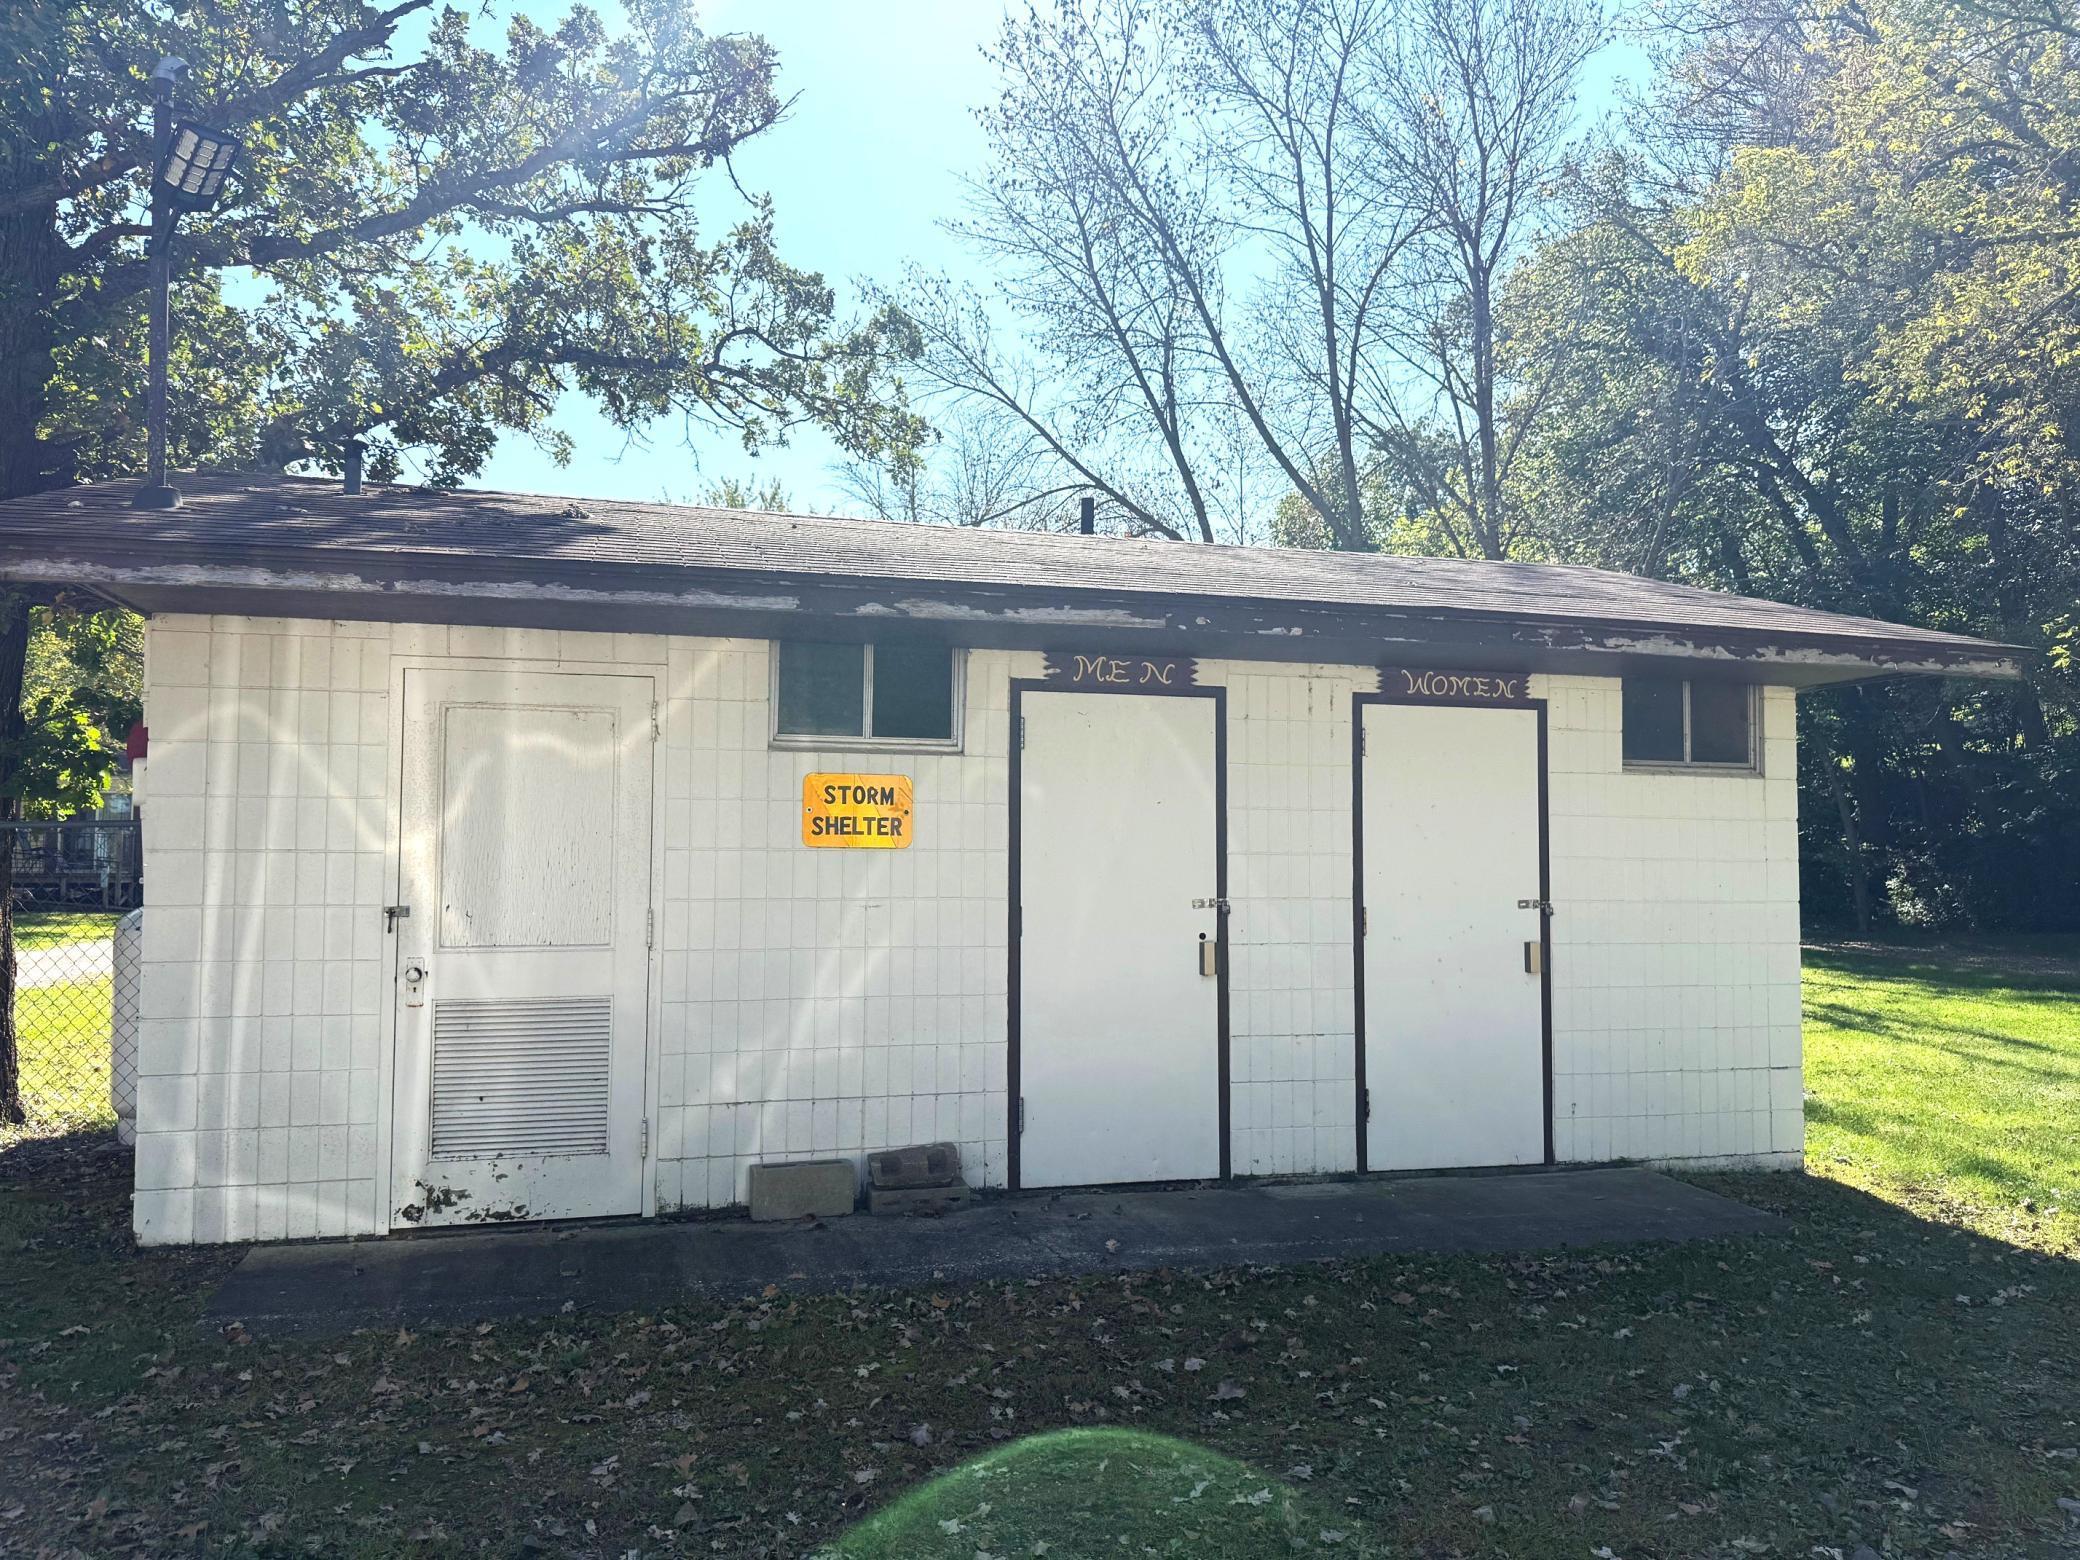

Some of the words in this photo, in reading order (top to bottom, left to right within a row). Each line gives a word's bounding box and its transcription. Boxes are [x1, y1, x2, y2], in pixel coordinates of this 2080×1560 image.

[1073, 655, 1175, 685] MEN
[1401, 669, 1517, 698] WOMEN
[824, 785, 894, 805] STORM
[811, 816, 902, 836] SHELTER
